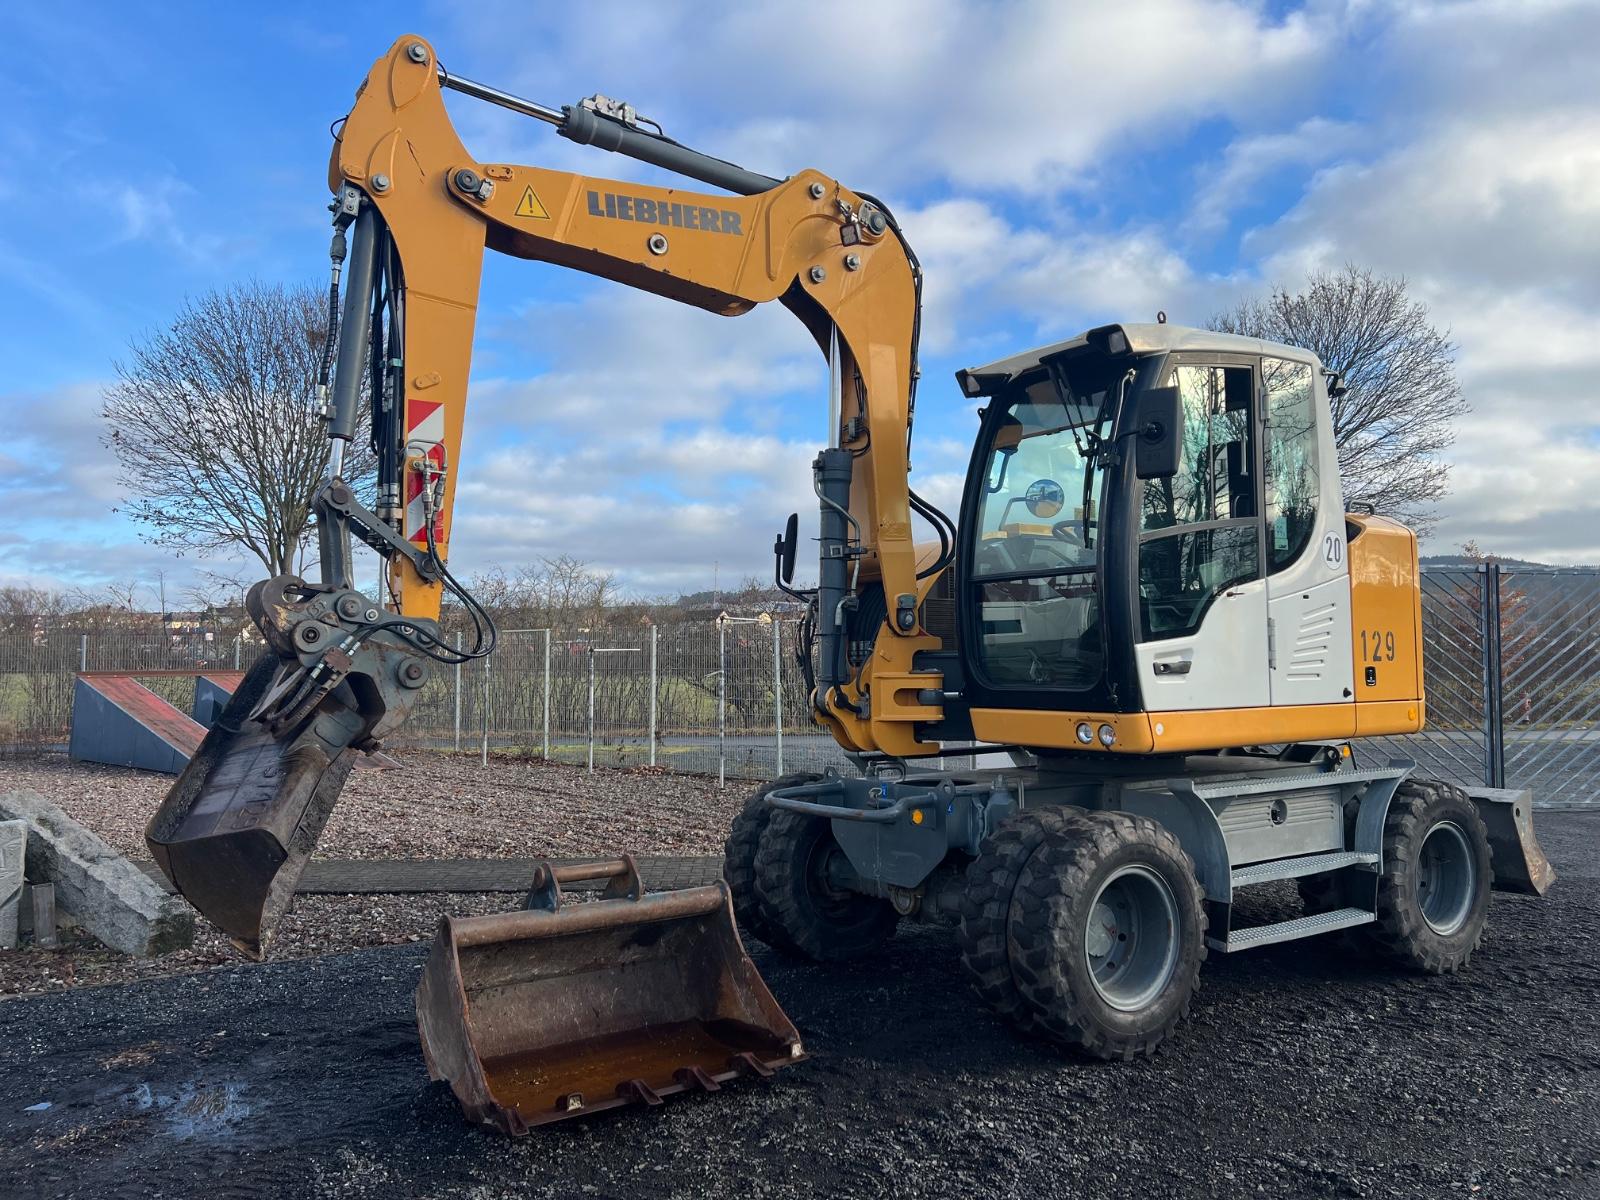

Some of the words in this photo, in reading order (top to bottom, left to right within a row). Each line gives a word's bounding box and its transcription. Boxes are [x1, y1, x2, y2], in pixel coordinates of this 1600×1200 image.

[587, 190, 744, 236] LIEBHERR
[1325, 536, 1341, 562] 20
[1360, 629, 1395, 662] 129
